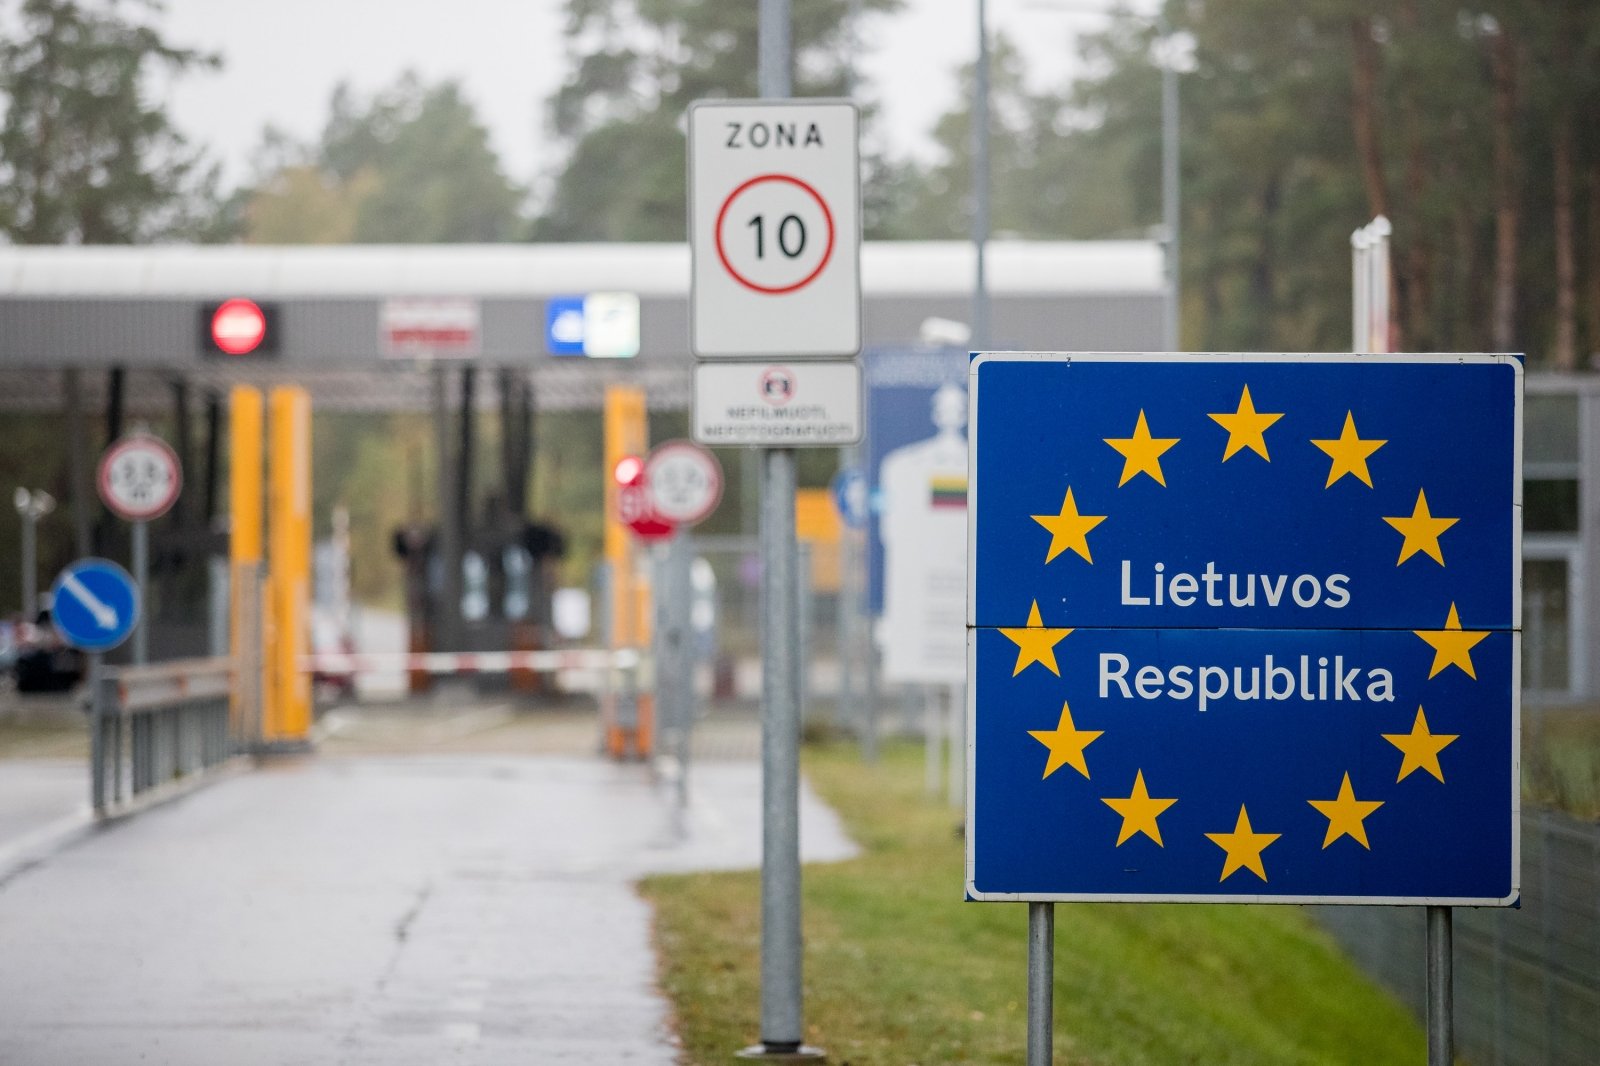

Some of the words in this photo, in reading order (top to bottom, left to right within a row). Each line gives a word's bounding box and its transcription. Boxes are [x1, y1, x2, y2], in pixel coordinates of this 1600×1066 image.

[725, 122, 823, 148] ZONA
[748, 214, 806, 259] 10
[1121, 560, 1351, 608] Lietuvos
[1099, 653, 1395, 711] Respublika
